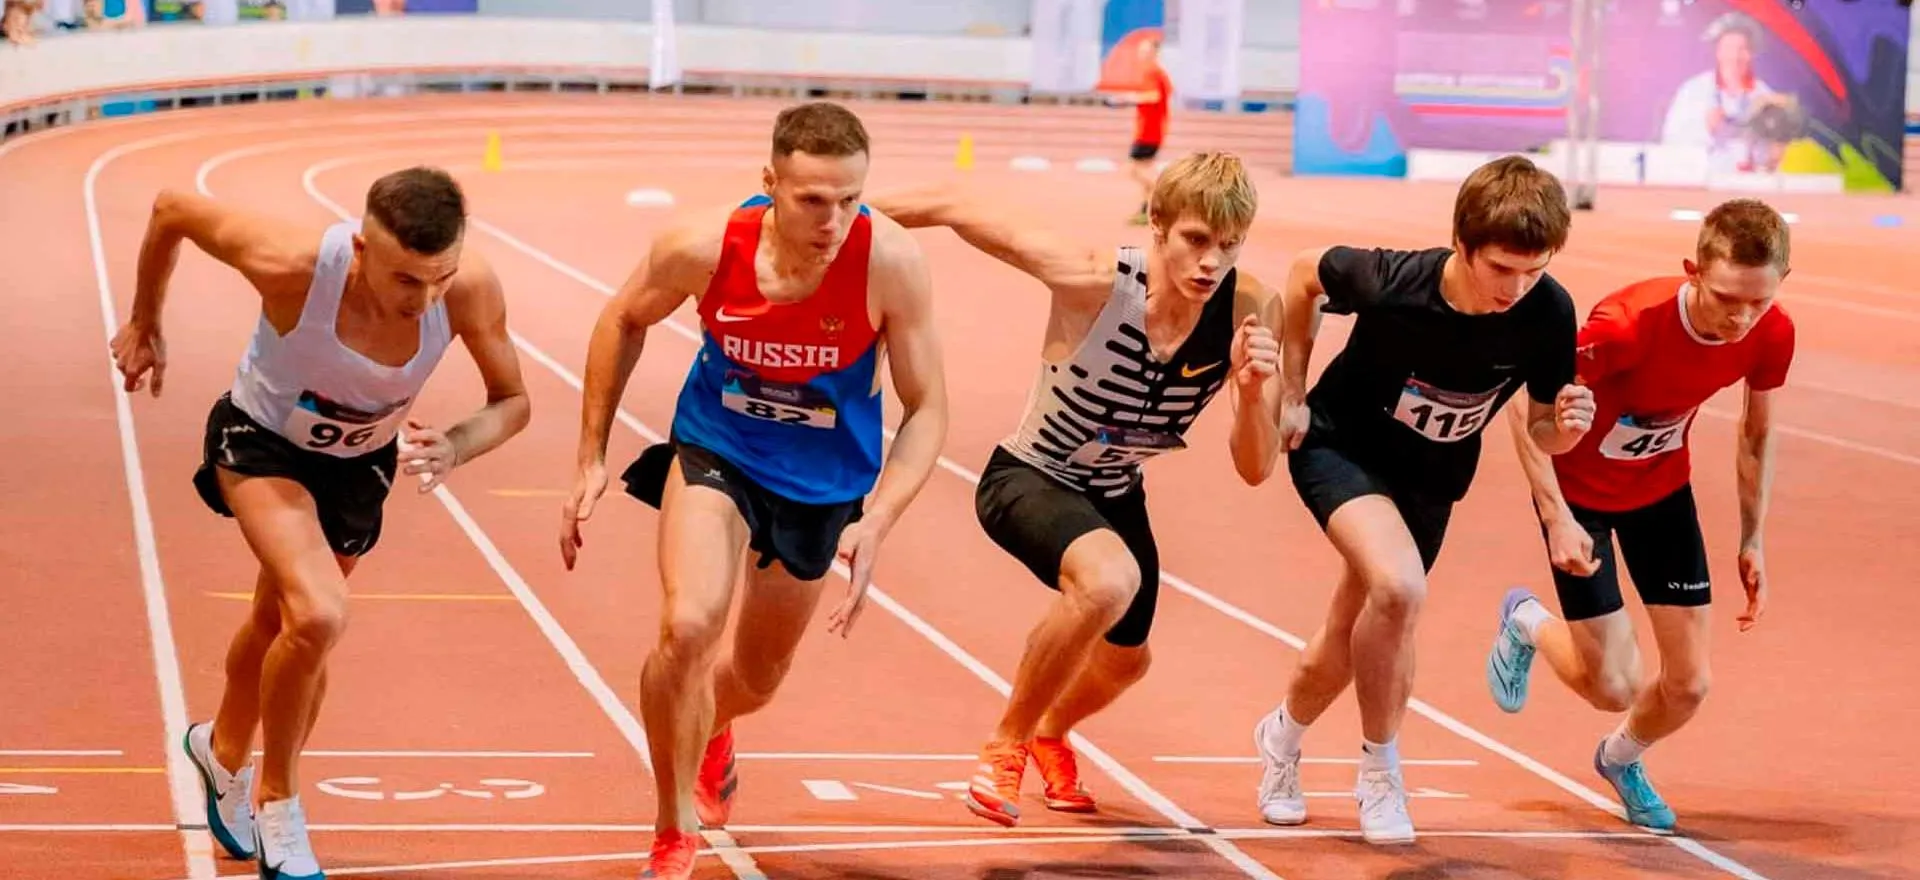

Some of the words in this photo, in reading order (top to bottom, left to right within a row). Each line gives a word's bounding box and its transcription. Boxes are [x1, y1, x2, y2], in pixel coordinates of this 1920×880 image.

[723, 333, 840, 368] RUSSIA
[744, 400, 811, 424] 82
[1410, 404, 1485, 438] 115
[305, 422, 377, 448] 96
[1621, 428, 1677, 456] 49
